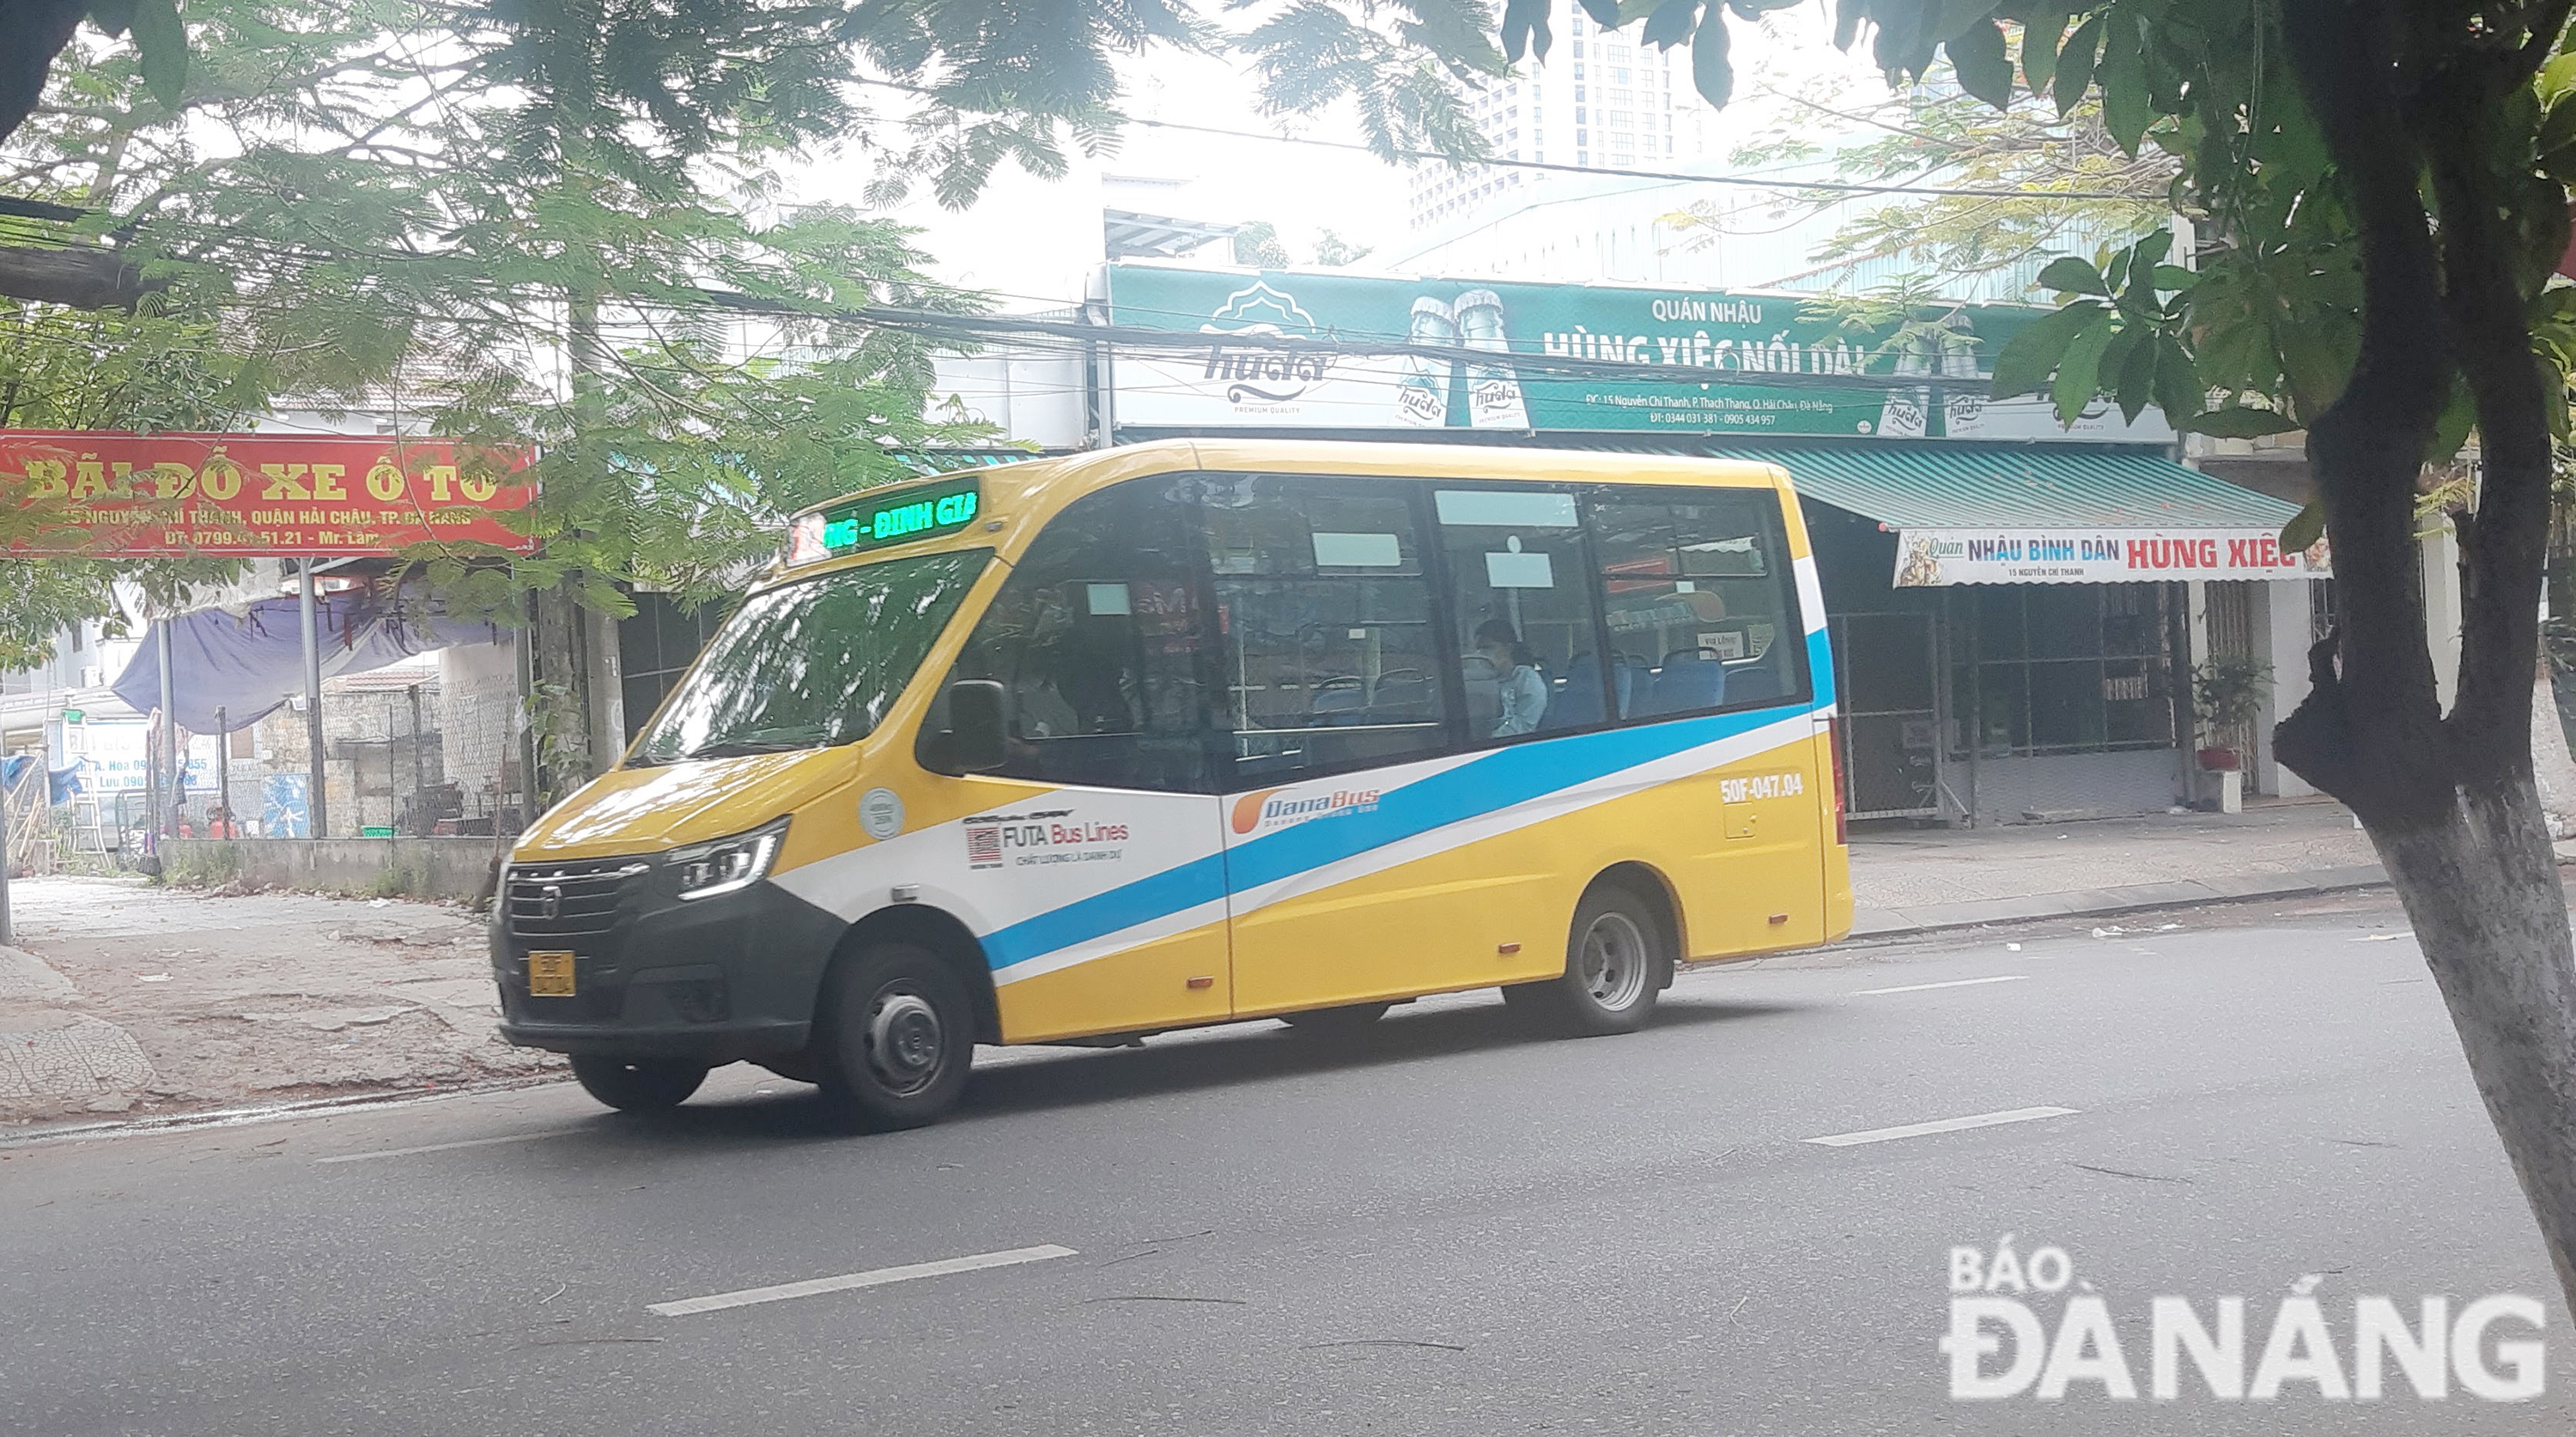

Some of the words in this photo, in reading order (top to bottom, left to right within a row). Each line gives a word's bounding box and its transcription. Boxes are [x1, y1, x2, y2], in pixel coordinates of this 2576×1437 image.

[1652, 297, 1706, 323] QUÁN
[1710, 300, 1762, 329] NHẬU
[1544, 324, 1650, 366] HÙNG
[1743, 330, 1801, 373] NỐI
[1398, 386, 1442, 418] huda
[1475, 385, 1517, 407] huda
[1603, 395, 1613, 404] 15
[1649, 395, 1663, 407] Chí
[1692, 397, 1699, 408] P.
[1950, 400, 1983, 418] huda
[1650, 412, 1664, 423] ĐT:
[1666, 413, 1685, 423] 0344
[1686, 413, 1700, 424] 031
[1704, 414, 1717, 424] 381
[1724, 414, 1744, 425] 0905
[1746, 415, 1759, 425] 434
[1760, 415, 1776, 426] 957
[1888, 401, 1923, 428] huda
[25, 452, 133, 500] BÃI
[153, 446, 242, 500] ĐỖ
[260, 463, 347, 500] XE
[366, 455, 405, 501] Ô
[252, 507, 295, 527] QUẬN
[300, 506, 325, 525] HẢI
[330, 507, 376, 525] CHÂU,
[380, 511, 401, 524] TP.
[319, 531, 343, 545] Mr.
[348, 530, 380, 545] Lâm
[1929, 537, 1964, 556] Quán
[1968, 535, 2021, 566] NHẬU
[2028, 535, 2075, 561] BÌNH
[2081, 535, 2119, 561] DÂN
[2127, 532, 2218, 569] HÙNG
[2008, 568, 2017, 577] 15
[2019, 566, 2047, 577] NGUYỄN
[2049, 566, 2059, 577] CHÍ
[2060, 567, 2085, 577] THANH
[1721, 773, 1803, 803] 50F-047.04
[1266, 789, 1380, 819] DanaBus
[1003, 825, 1048, 848] FUTA
[1050, 823, 1082, 845] Bus
[1085, 821, 1129, 842] Lines
